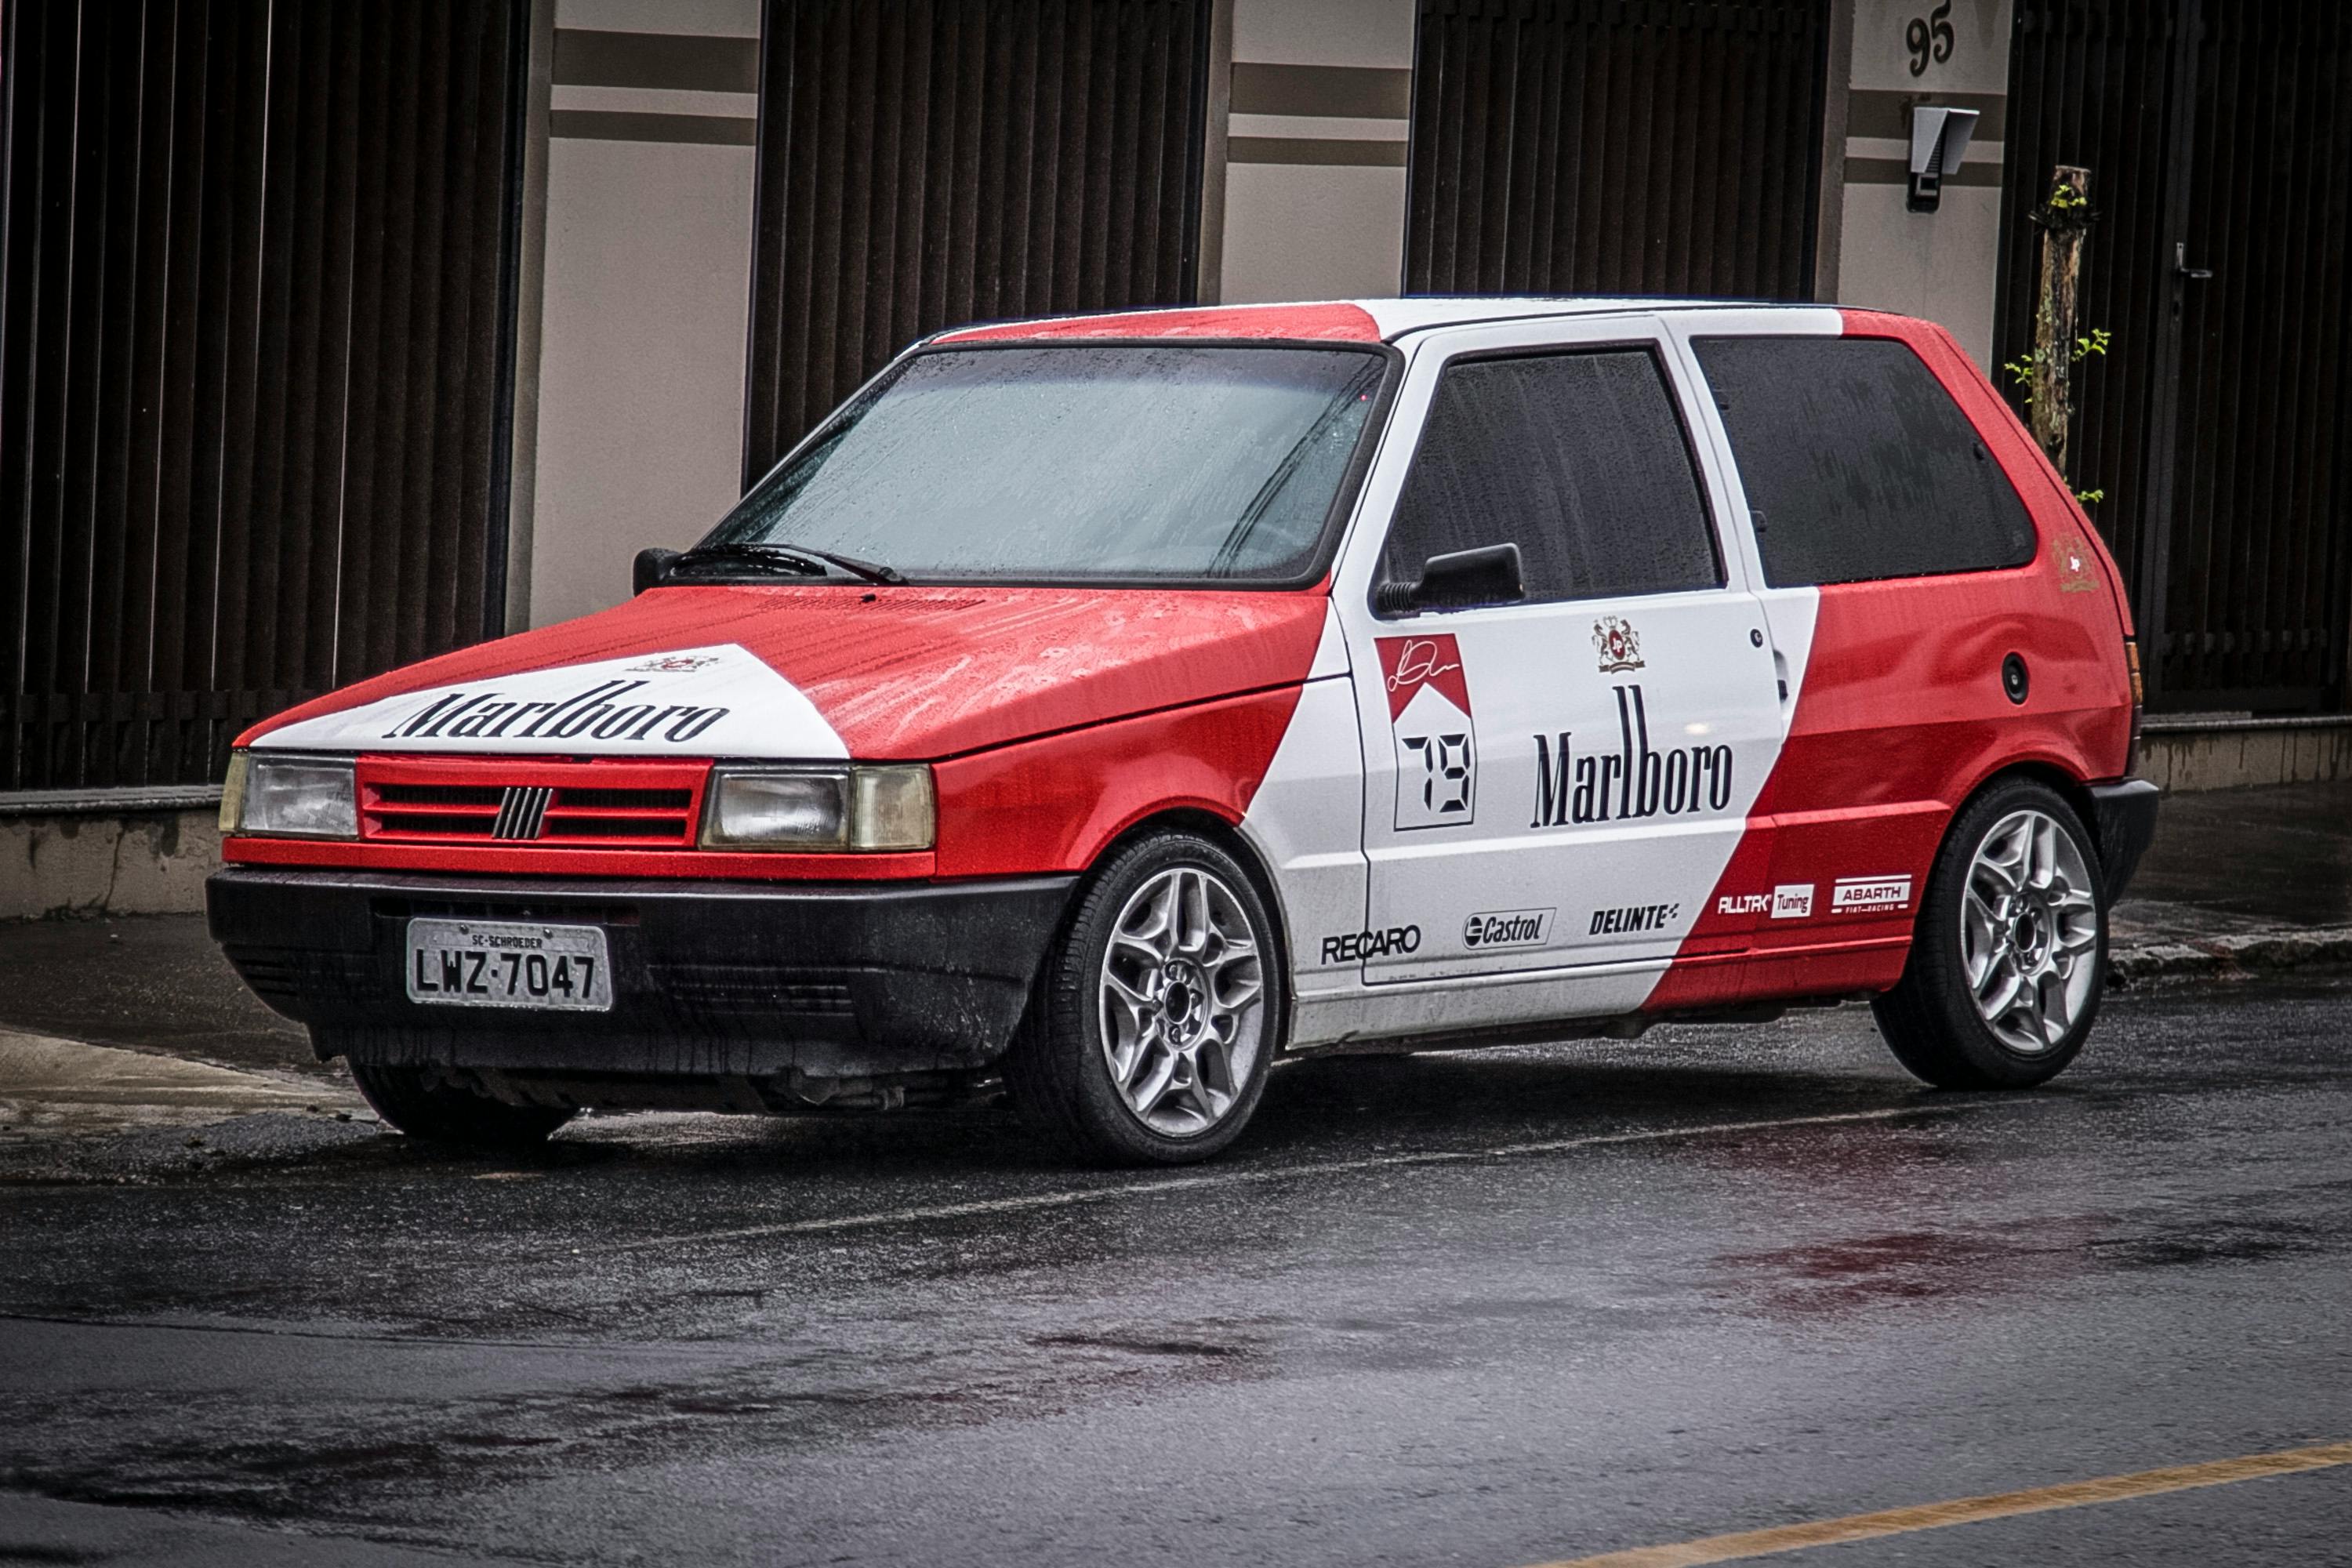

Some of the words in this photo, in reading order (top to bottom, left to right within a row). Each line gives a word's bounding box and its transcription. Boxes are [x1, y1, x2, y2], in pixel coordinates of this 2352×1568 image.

[1906, 0, 1955, 77] 95
[382, 680, 729, 742] Marlboro
[1402, 733, 1471, 812] 79
[1530, 684, 1733, 828] Marlboro
[1718, 895, 1771, 914] ALLTAK
[1777, 893, 1809, 913] Tuning
[1843, 886, 1901, 901] ABARTH
[1483, 914, 1544, 945] Castrol
[1589, 904, 1671, 935] DELINTE
[472, 934, 543, 949] SC-SCHROEDER
[1321, 924, 1421, 964] RECARO
